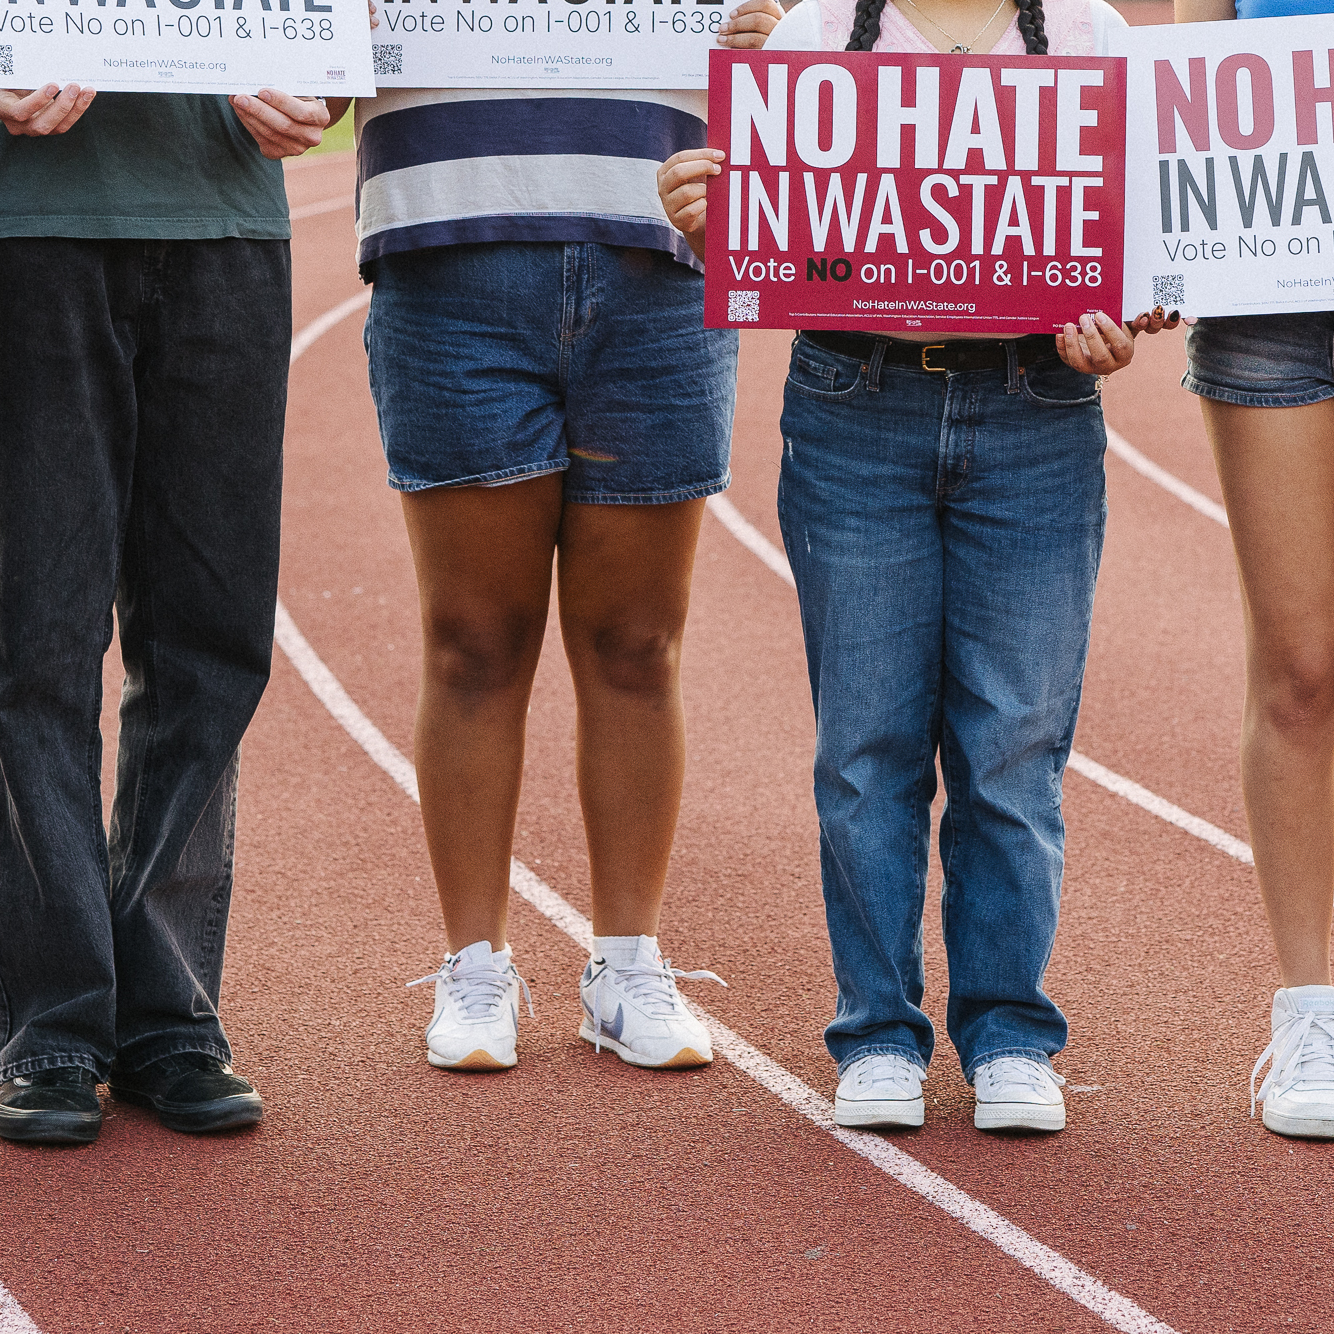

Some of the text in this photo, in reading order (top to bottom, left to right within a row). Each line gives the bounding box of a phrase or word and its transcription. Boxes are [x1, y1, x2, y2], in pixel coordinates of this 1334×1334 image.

[65, 12, 102, 35] No
[113, 18, 145, 36] on
[157, 15, 222, 38] I-001
[236, 17, 252, 38] &
[263, 17, 333, 40] I-638
[384, 10, 722, 33] Vote No on I-001 & I-638
[104, 57, 227, 72] NoHateInWAState.org
[491, 55, 613, 67] NoHateInWAState.org
[730, 63, 1104, 171] NO HATE
[1154, 53, 1275, 154] NO
[1158, 157, 1217, 233] IN
[1228, 151, 1332, 228] WA
[729, 171, 1103, 256] IN WA STATE
[1163, 239, 1226, 262] Vote
[1238, 235, 1276, 258] No
[1288, 236, 1320, 255] on
[729, 256, 1102, 286] Vote NO on I-001 & I-638
[853, 299, 975, 313] NoHateInWAState.org
